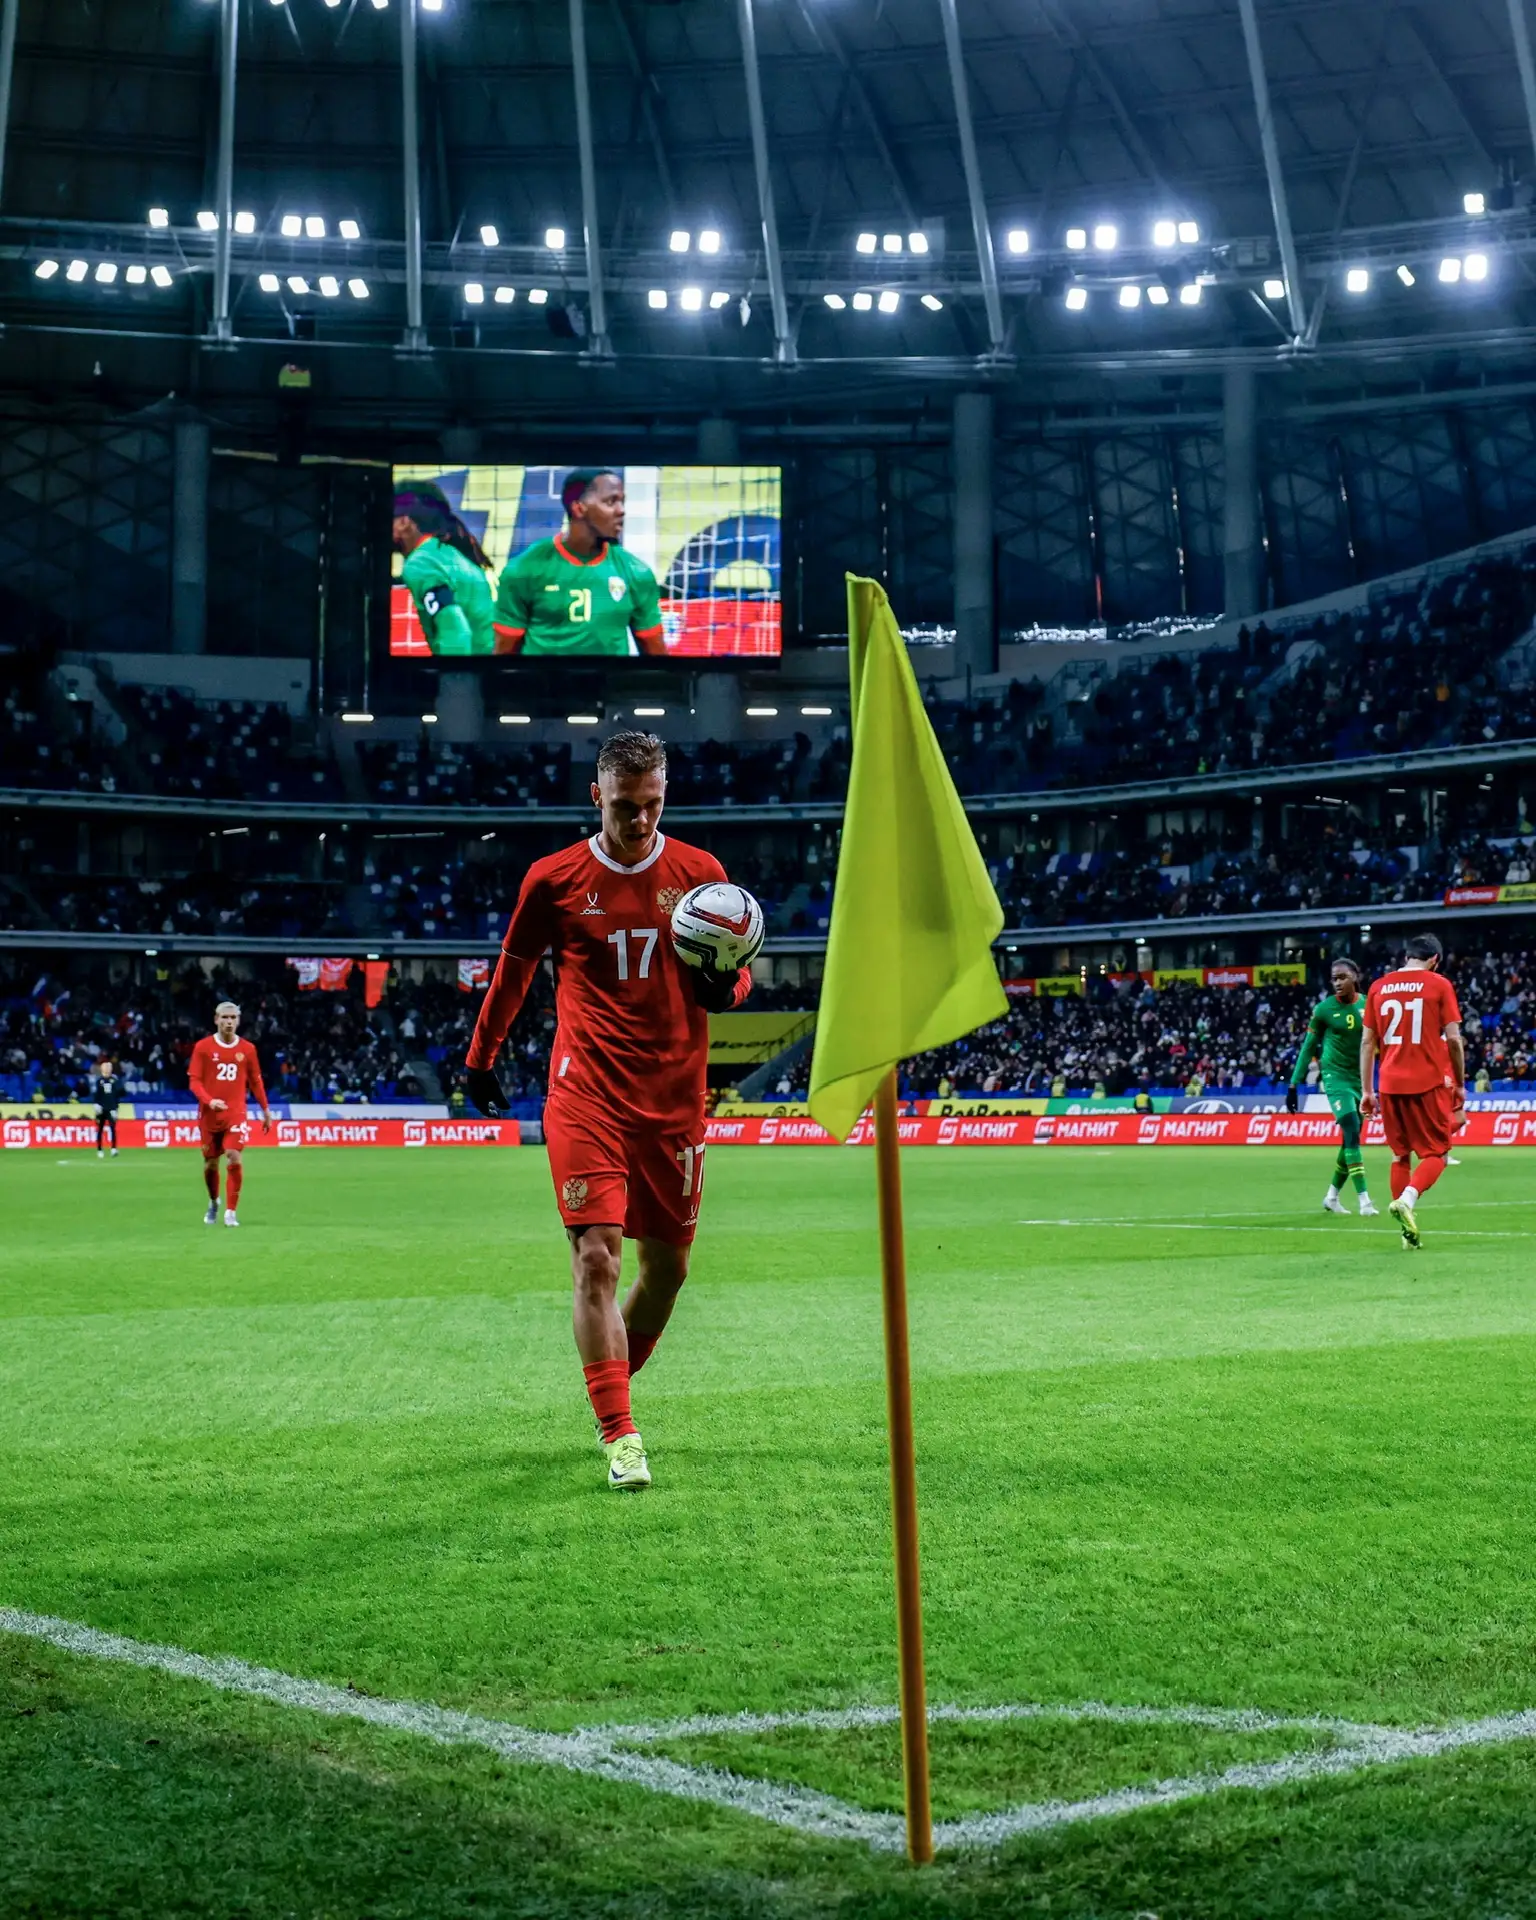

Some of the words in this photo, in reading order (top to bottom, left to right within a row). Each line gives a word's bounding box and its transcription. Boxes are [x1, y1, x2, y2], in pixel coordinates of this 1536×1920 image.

[568, 588, 592, 622] 21
[608, 928, 658, 980] 17
[1381, 983, 1424, 995] ADAMOV
[1346, 1014, 1355, 1030] 9
[1381, 998, 1423, 1045] 21
[216, 1063, 237, 1081] 28
[305, 1126, 379, 1142] МАГНИТ
[430, 1126, 502, 1142] МАГНИТ
[704, 1123, 744, 1138] АГНИТ
[959, 1122, 1018, 1138] МАГНИТ
[1056, 1121, 1119, 1138] МАГНИТ
[1163, 1120, 1229, 1137] МАГНИТ
